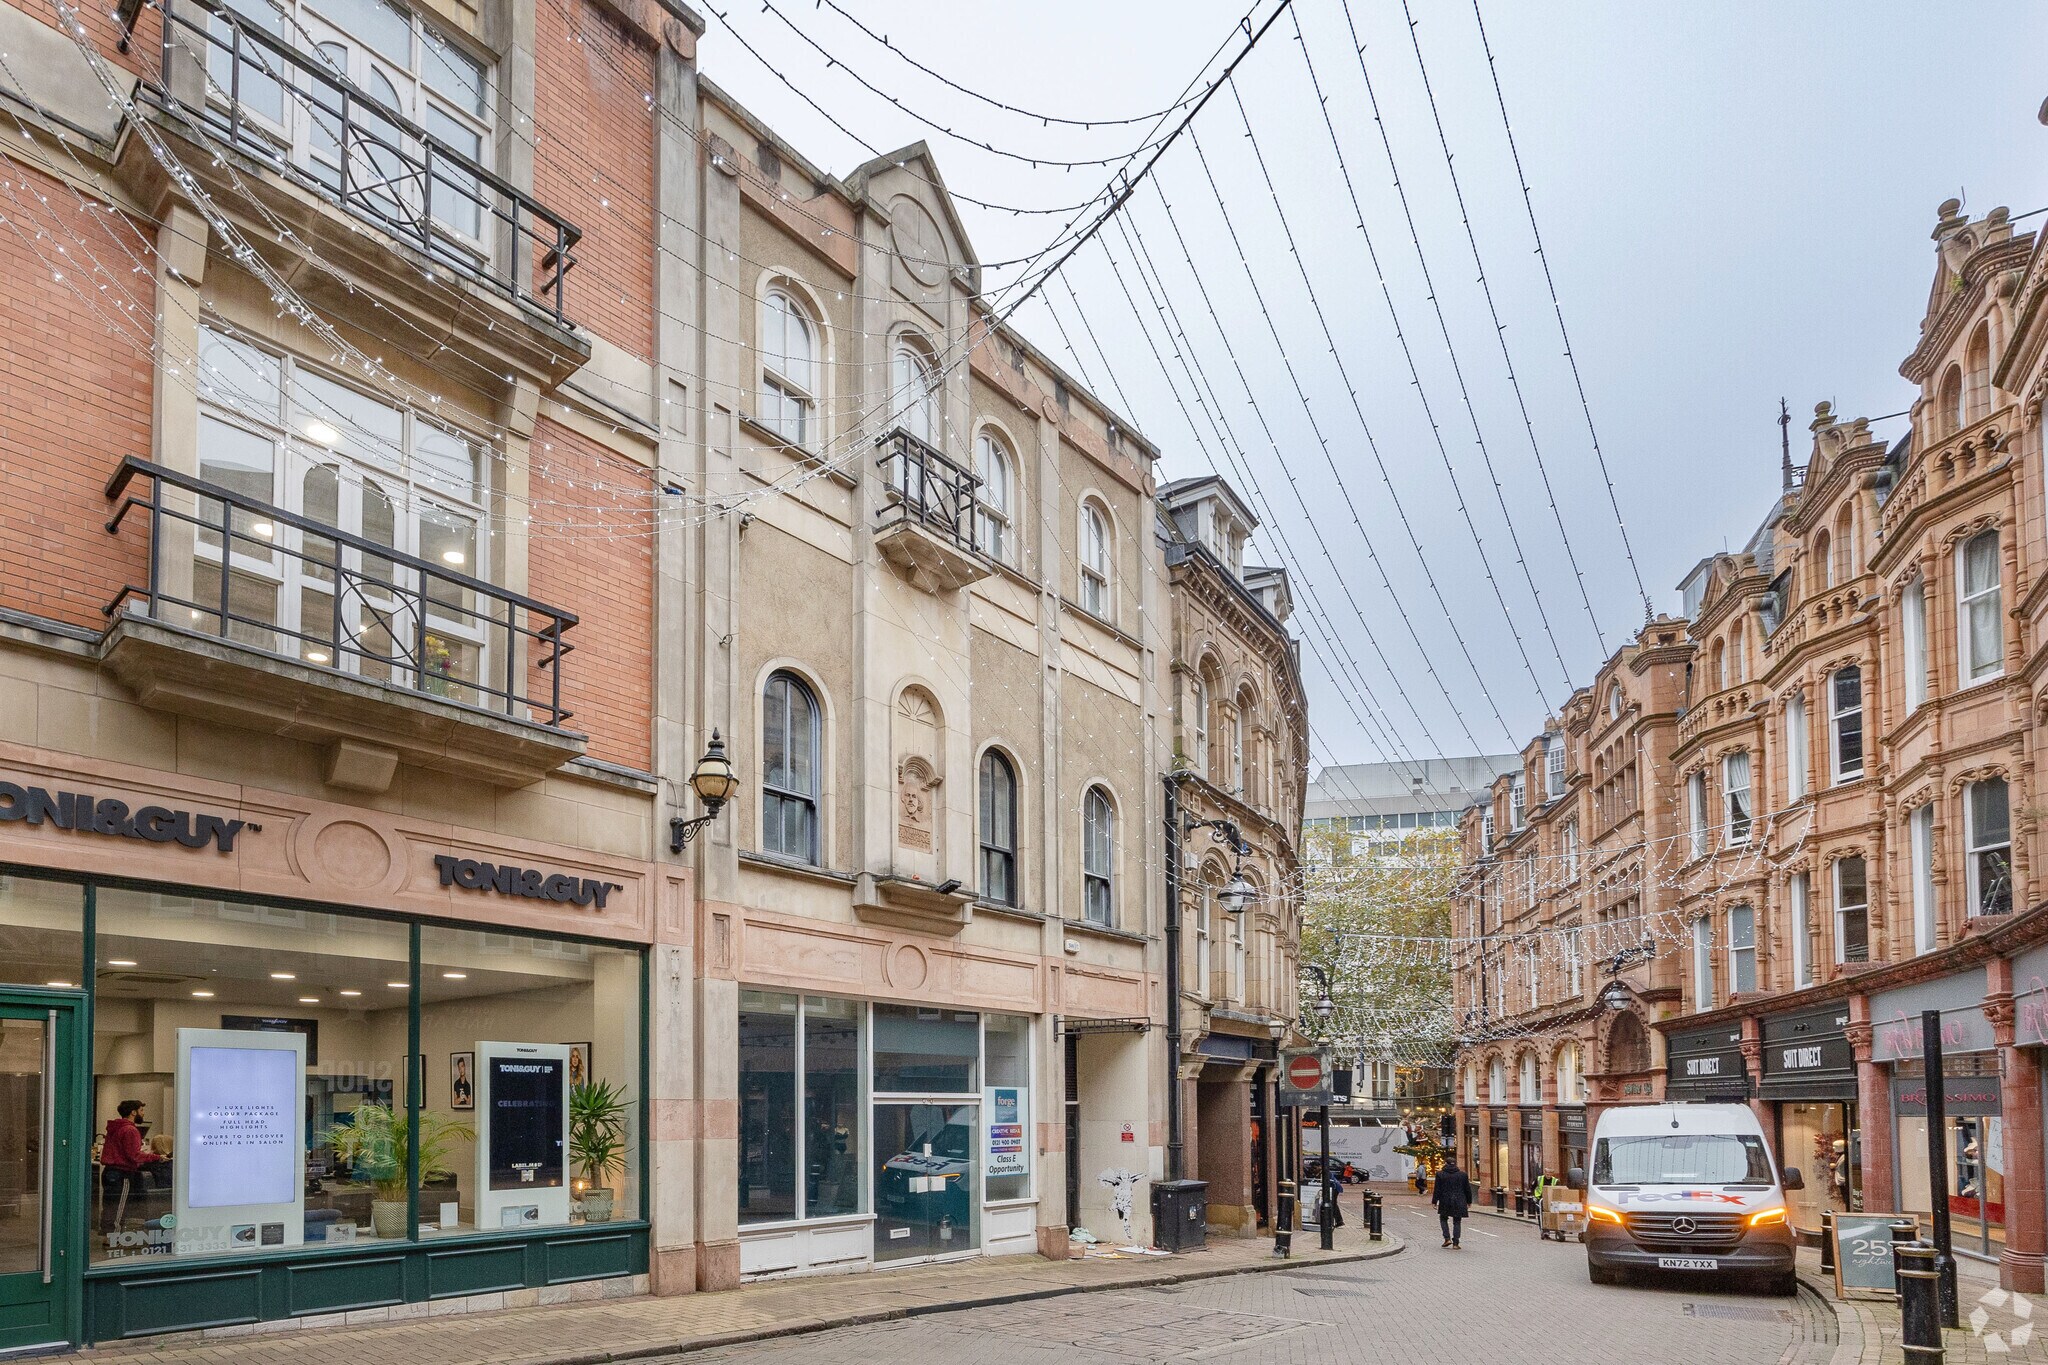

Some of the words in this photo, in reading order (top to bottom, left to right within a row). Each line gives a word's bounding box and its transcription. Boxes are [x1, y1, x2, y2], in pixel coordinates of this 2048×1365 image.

[1783, 1049, 1798, 1069] SUIT
[1798, 1046, 1822, 1067] DIRECT
[500, 1064, 541, 1073] TONI&GUY
[1686, 1059, 1699, 1076] SUIT
[1699, 1057, 1720, 1074] DIRECT
[997, 1096, 1016, 1107] forge
[997, 1155, 1012, 1163] Class
[1012, 1154, 1017, 1162] E
[989, 1164, 1024, 1174] Opportunity
[1618, 1190, 1747, 1206] FedEx
[106, 1226, 225, 1247] TONI&GUY
[107, 1249, 127, 1258] TEL
[141, 1245, 167, 1255] 0121
[1663, 1260, 1690, 1268] KN72
[1693, 1261, 1713, 1269] YXX
